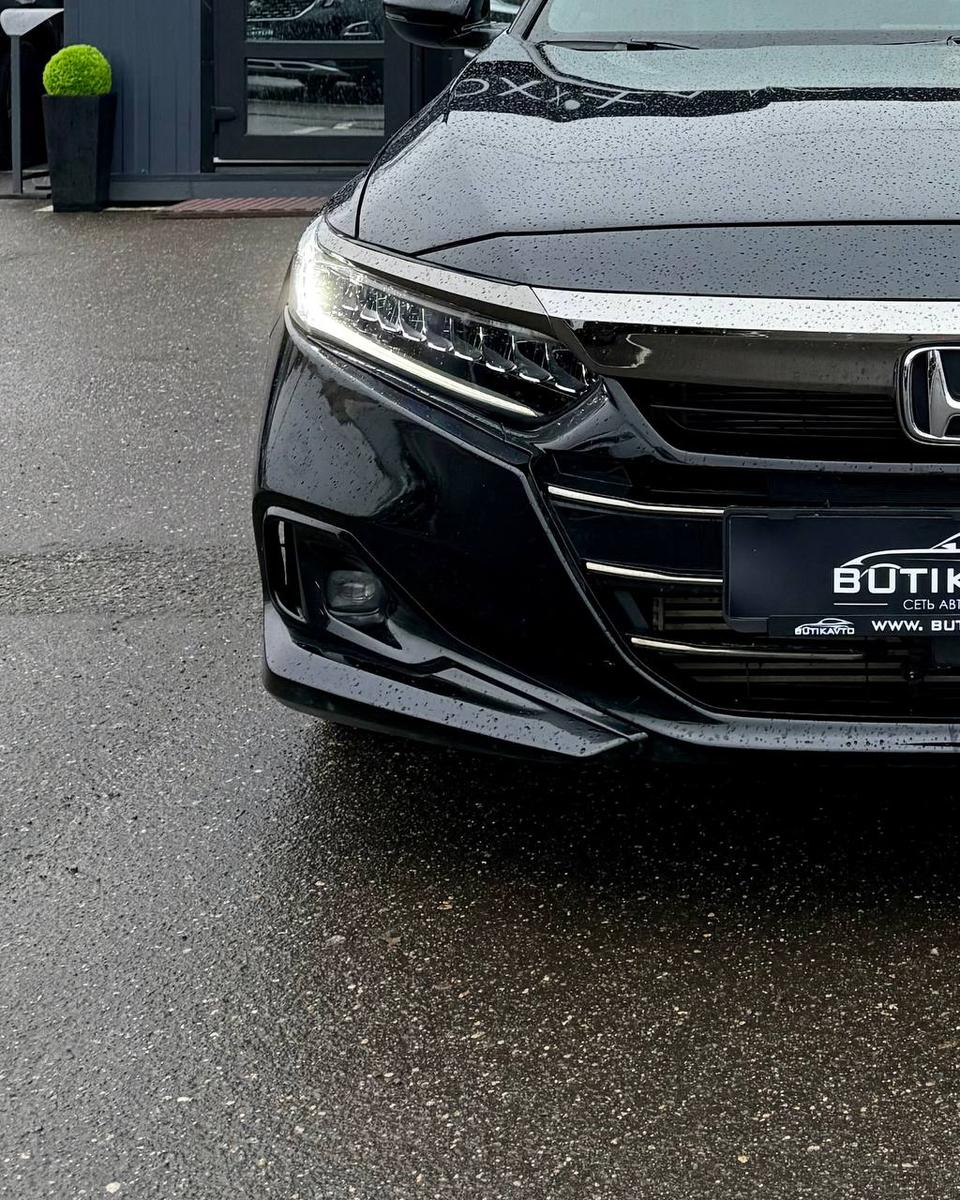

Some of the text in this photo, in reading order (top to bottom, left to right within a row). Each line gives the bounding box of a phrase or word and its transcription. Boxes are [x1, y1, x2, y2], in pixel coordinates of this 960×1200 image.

[903, 599, 935, 610] СЕТЬ
[795, 627, 855, 635] BUTIKAVTO
[871, 620, 923, 631] WWW.
